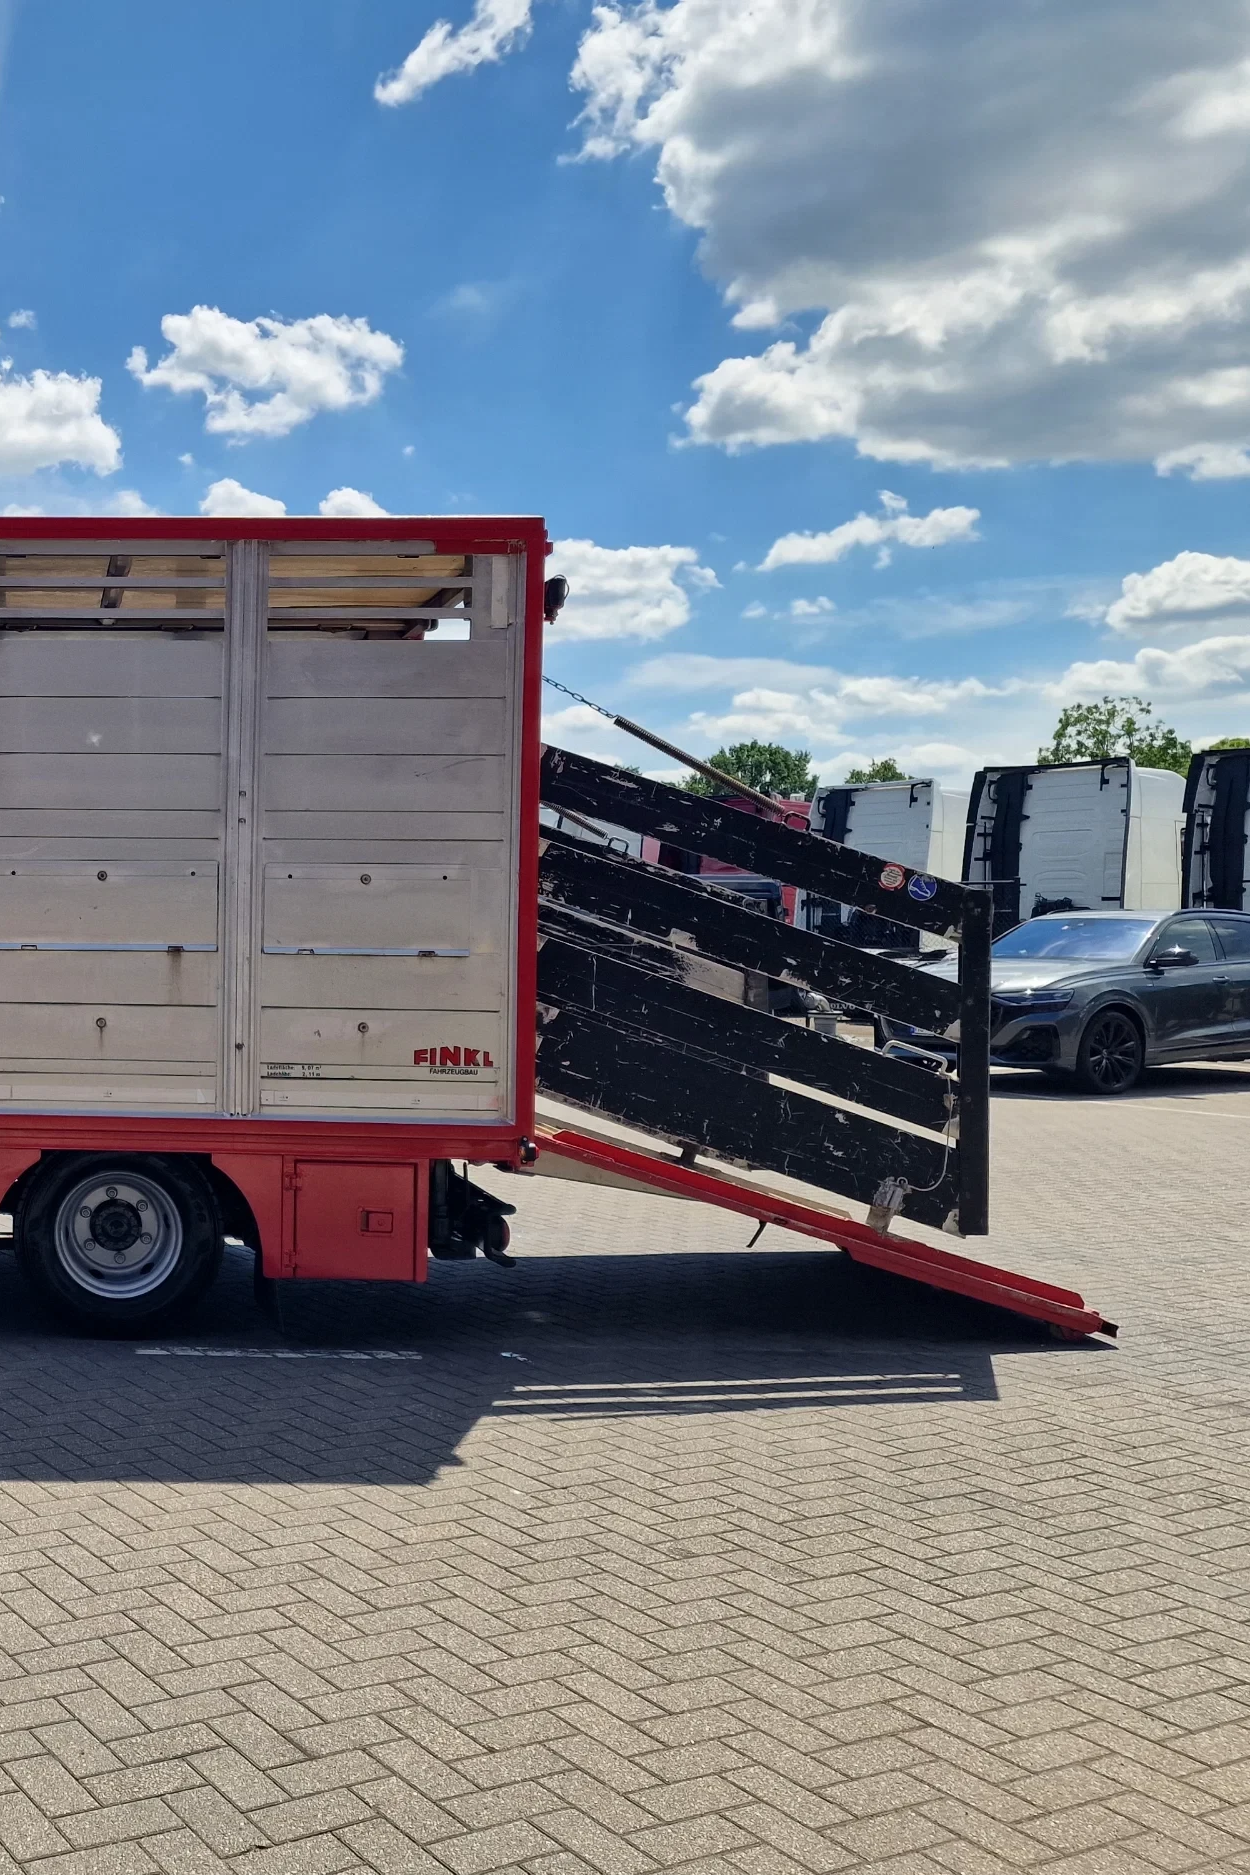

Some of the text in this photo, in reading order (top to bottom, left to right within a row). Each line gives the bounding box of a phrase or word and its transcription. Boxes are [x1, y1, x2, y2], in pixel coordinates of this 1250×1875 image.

[830, 1001, 856, 1010] OLVO
[413, 1045, 494, 1068] FINKL
[429, 1067, 478, 1076] FAHRZEUGBAU
